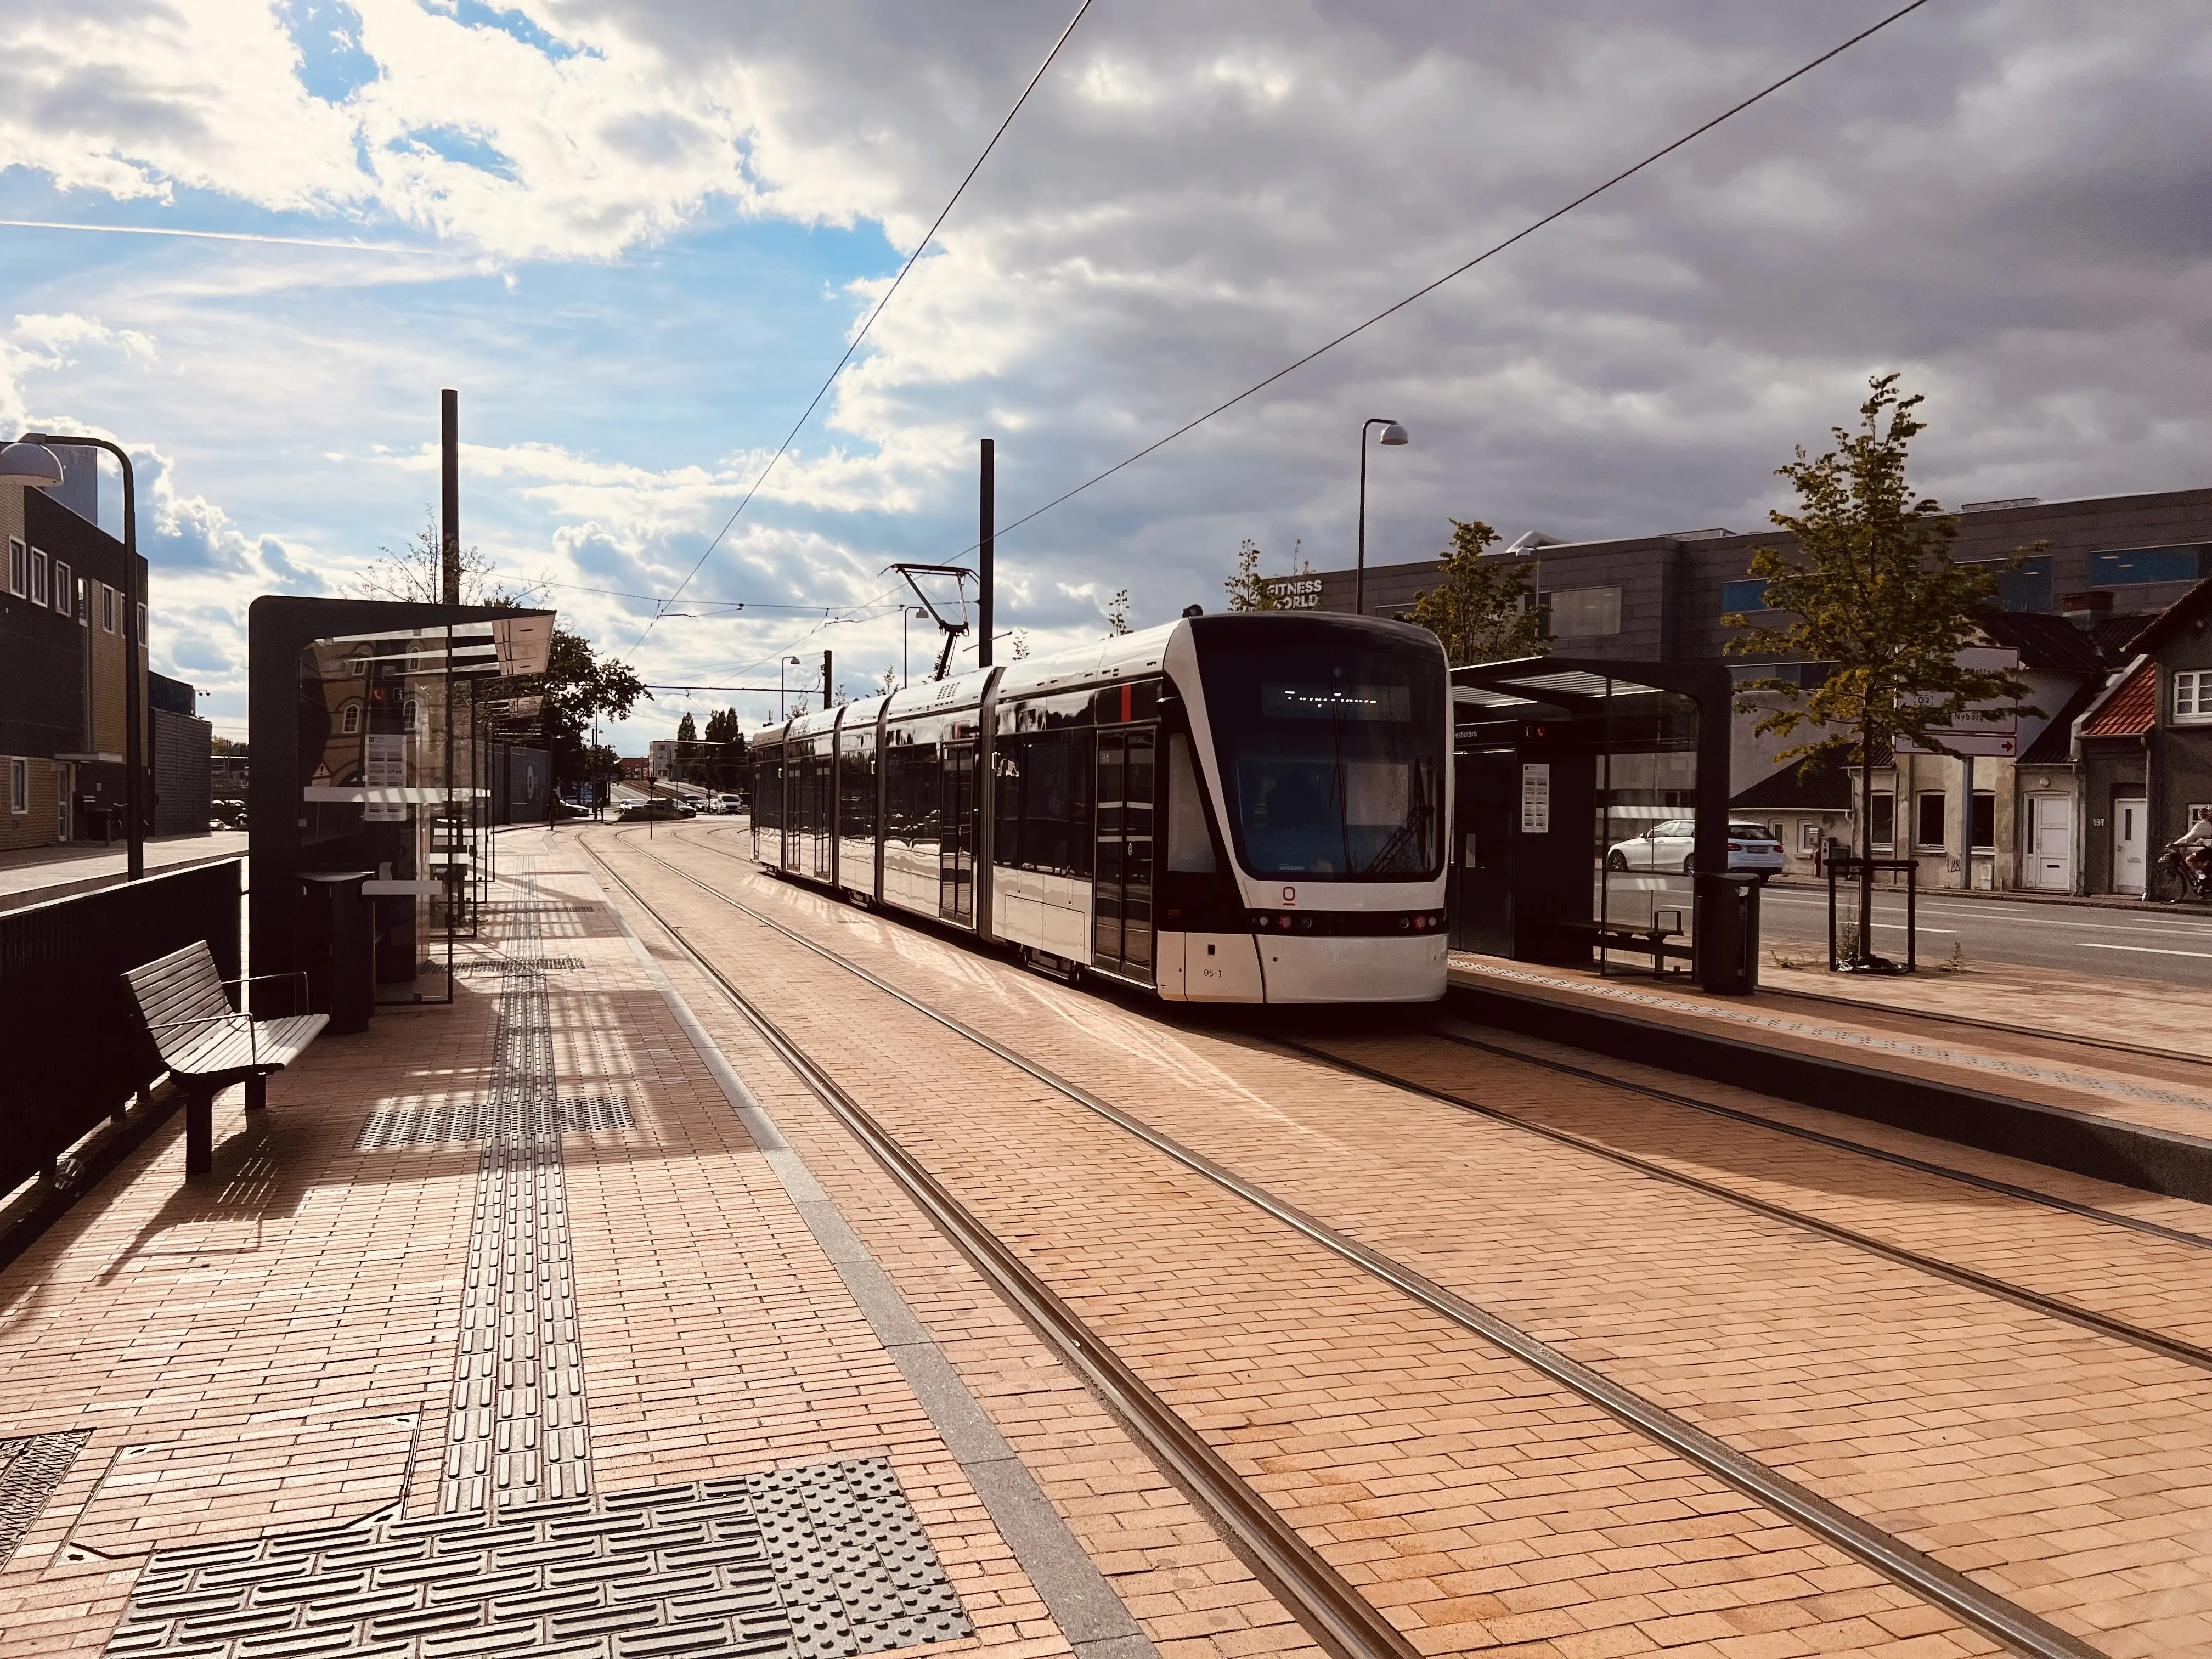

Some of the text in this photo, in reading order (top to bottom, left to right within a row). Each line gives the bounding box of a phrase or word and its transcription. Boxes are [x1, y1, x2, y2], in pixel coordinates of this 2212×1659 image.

[1267, 580, 1322, 595] FITNESS
[1954, 713, 1984, 723] Nyborg
[2093, 818, 2105, 827] 137
[1204, 968, 1222, 978] 05-1
